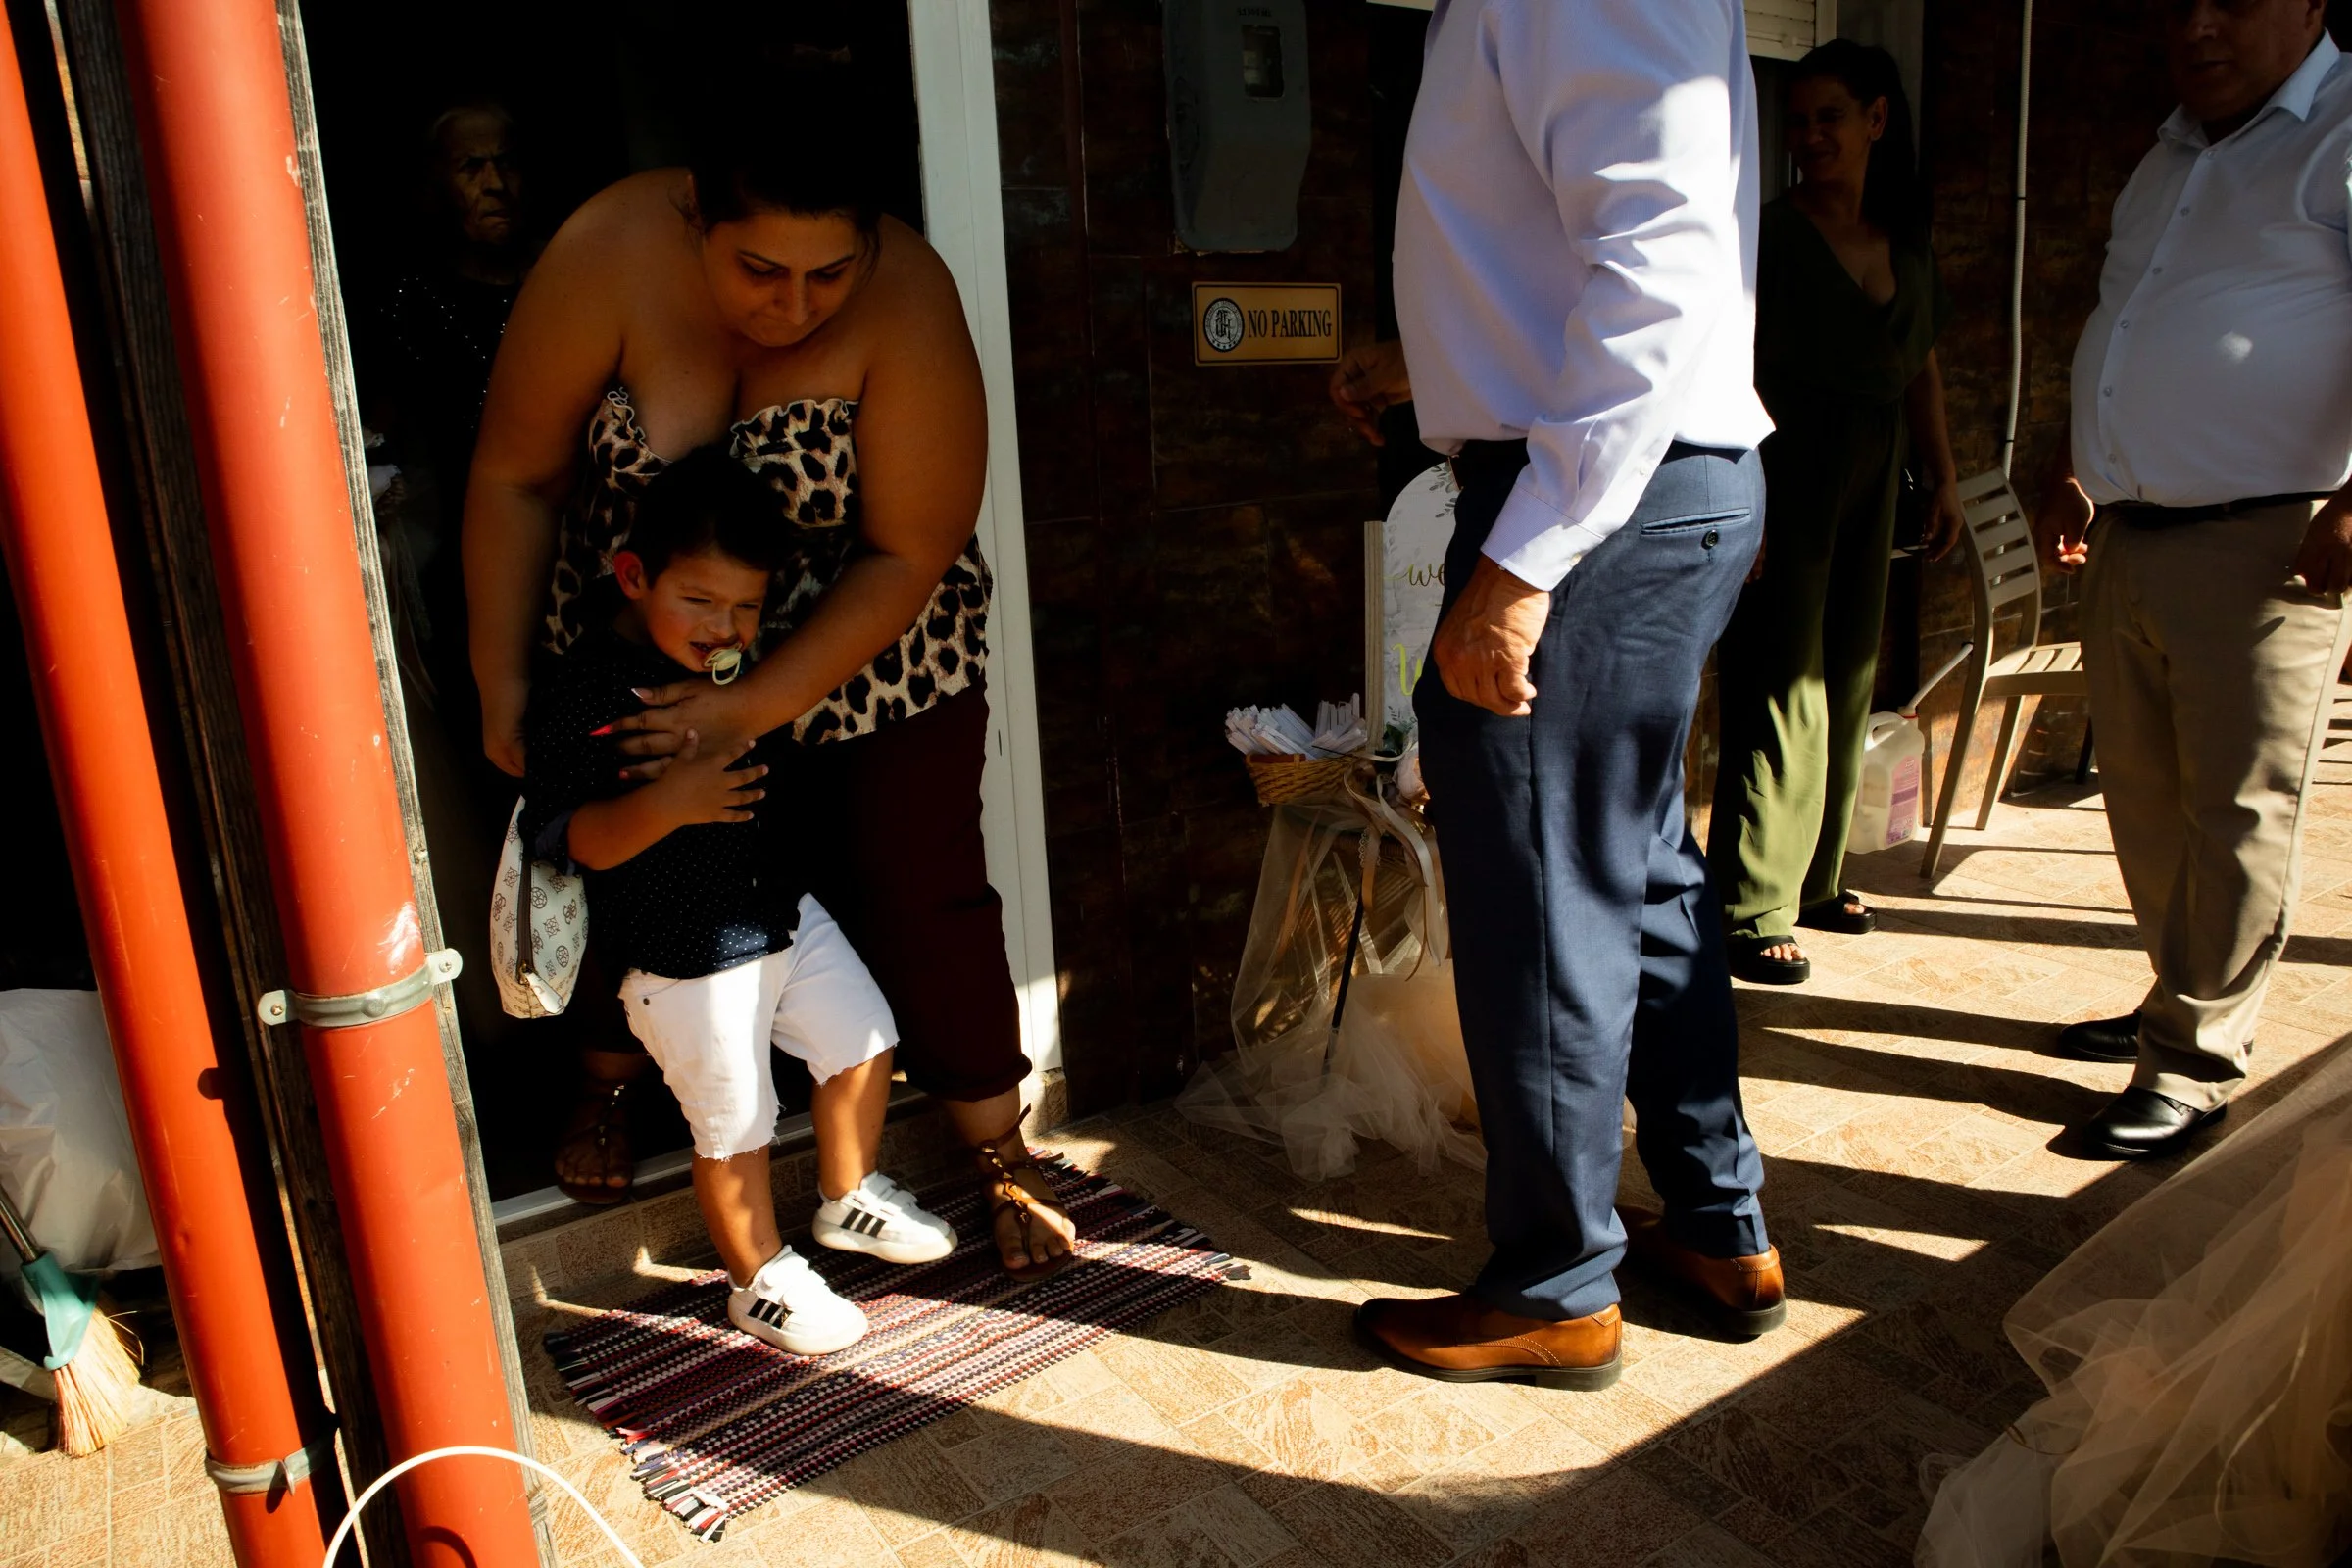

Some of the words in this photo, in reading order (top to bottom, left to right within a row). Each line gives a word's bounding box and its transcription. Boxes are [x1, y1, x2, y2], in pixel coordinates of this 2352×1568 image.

[1248, 310, 1268, 338] NO
[1271, 310, 1332, 338] PARKING
[1385, 564, 1446, 586] we
